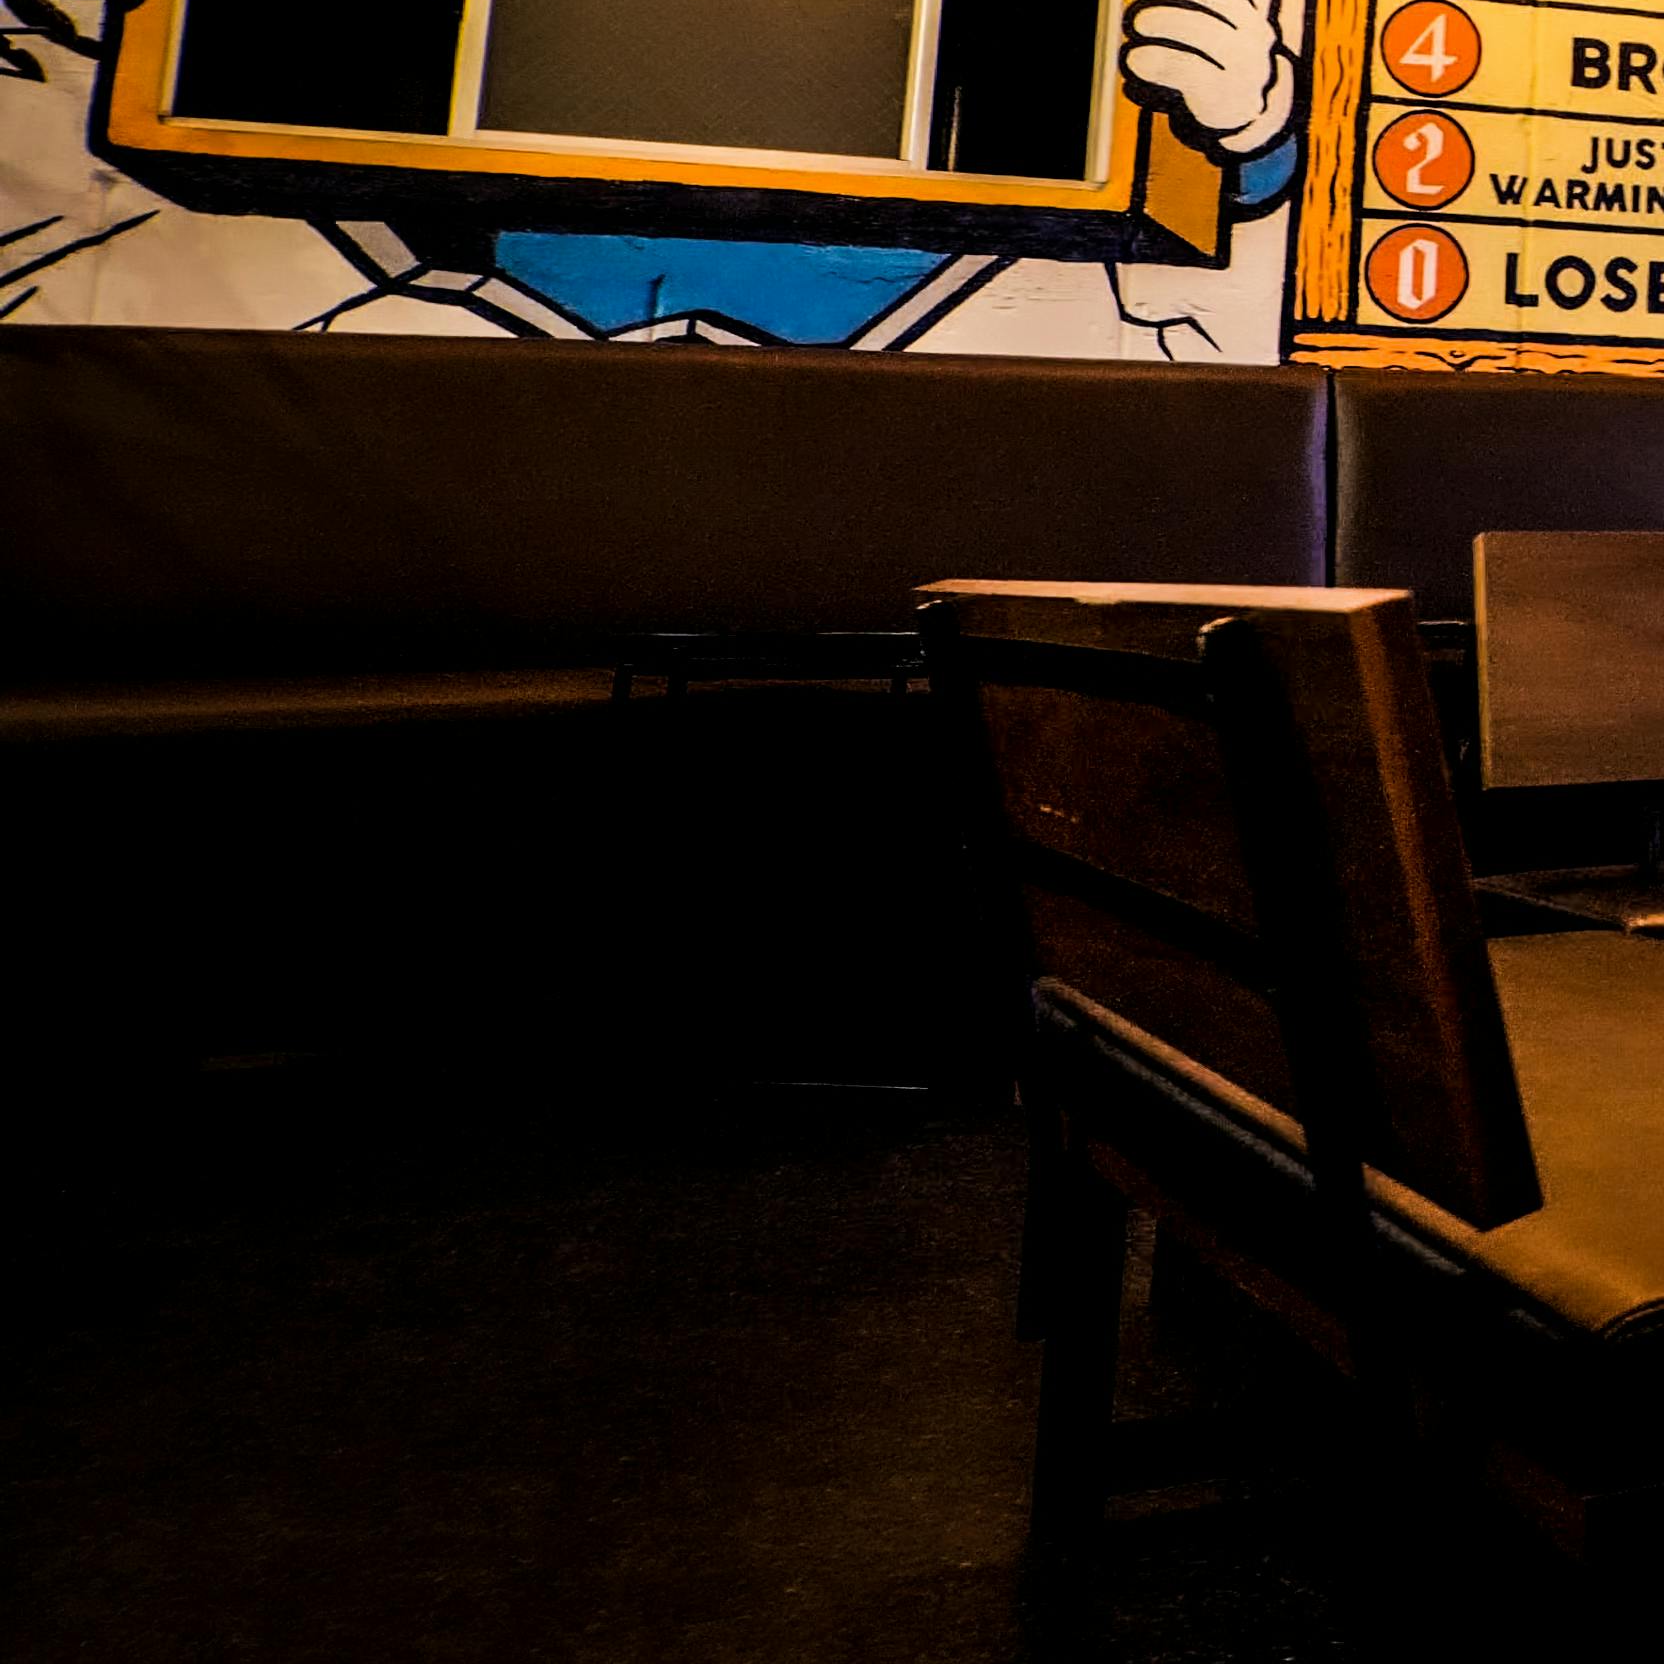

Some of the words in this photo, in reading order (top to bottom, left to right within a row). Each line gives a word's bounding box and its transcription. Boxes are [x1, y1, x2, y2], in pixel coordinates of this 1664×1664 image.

[1399, 12, 1458, 83] 4
[1403, 122, 1445, 195] 2
[1396, 238, 1439, 310] 0
